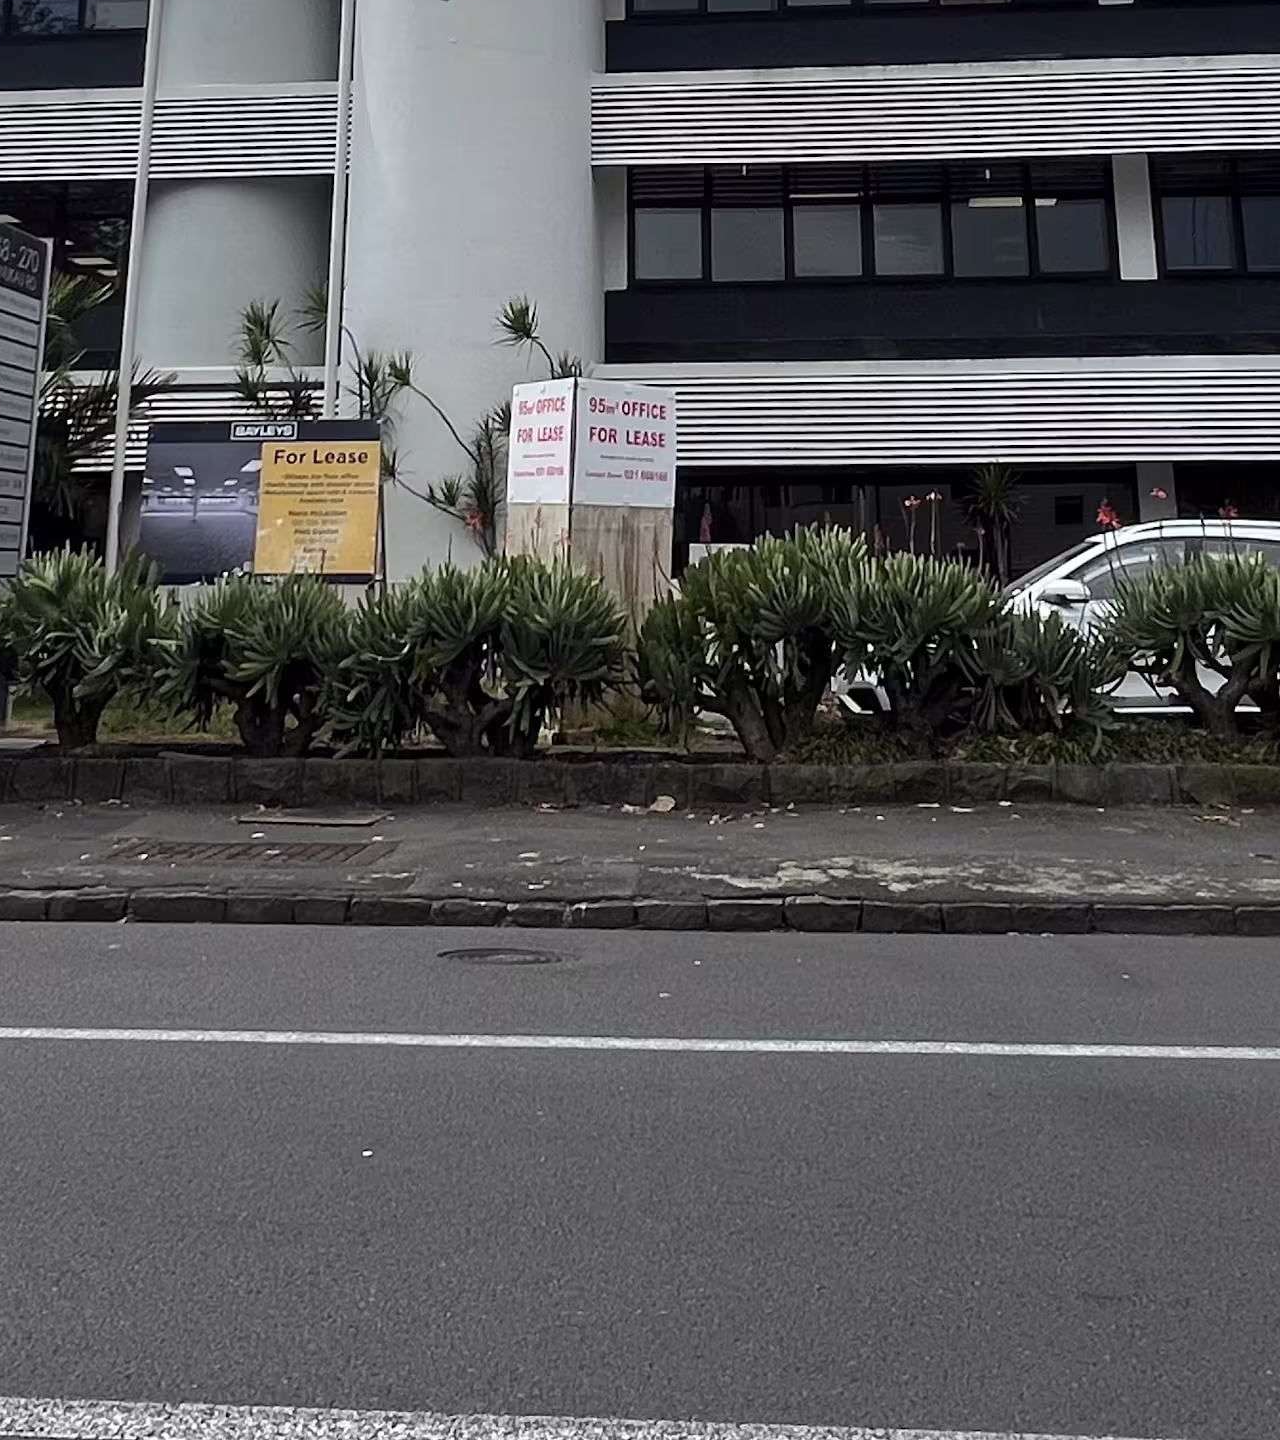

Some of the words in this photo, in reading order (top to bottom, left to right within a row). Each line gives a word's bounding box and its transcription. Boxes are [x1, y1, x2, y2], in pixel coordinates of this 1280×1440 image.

[18, 245, 40, 273] 270
[536, 396, 566, 414] OFFICE
[622, 400, 666, 420] OFFICE
[235, 425, 293, 436] BAYLEYS
[517, 427, 533, 443] FOR
[537, 425, 564, 442] LEASE
[589, 427, 617, 444] FOR
[626, 429, 666, 448] LEASE
[274, 449, 306, 465] For
[313, 449, 368, 465] Lease
